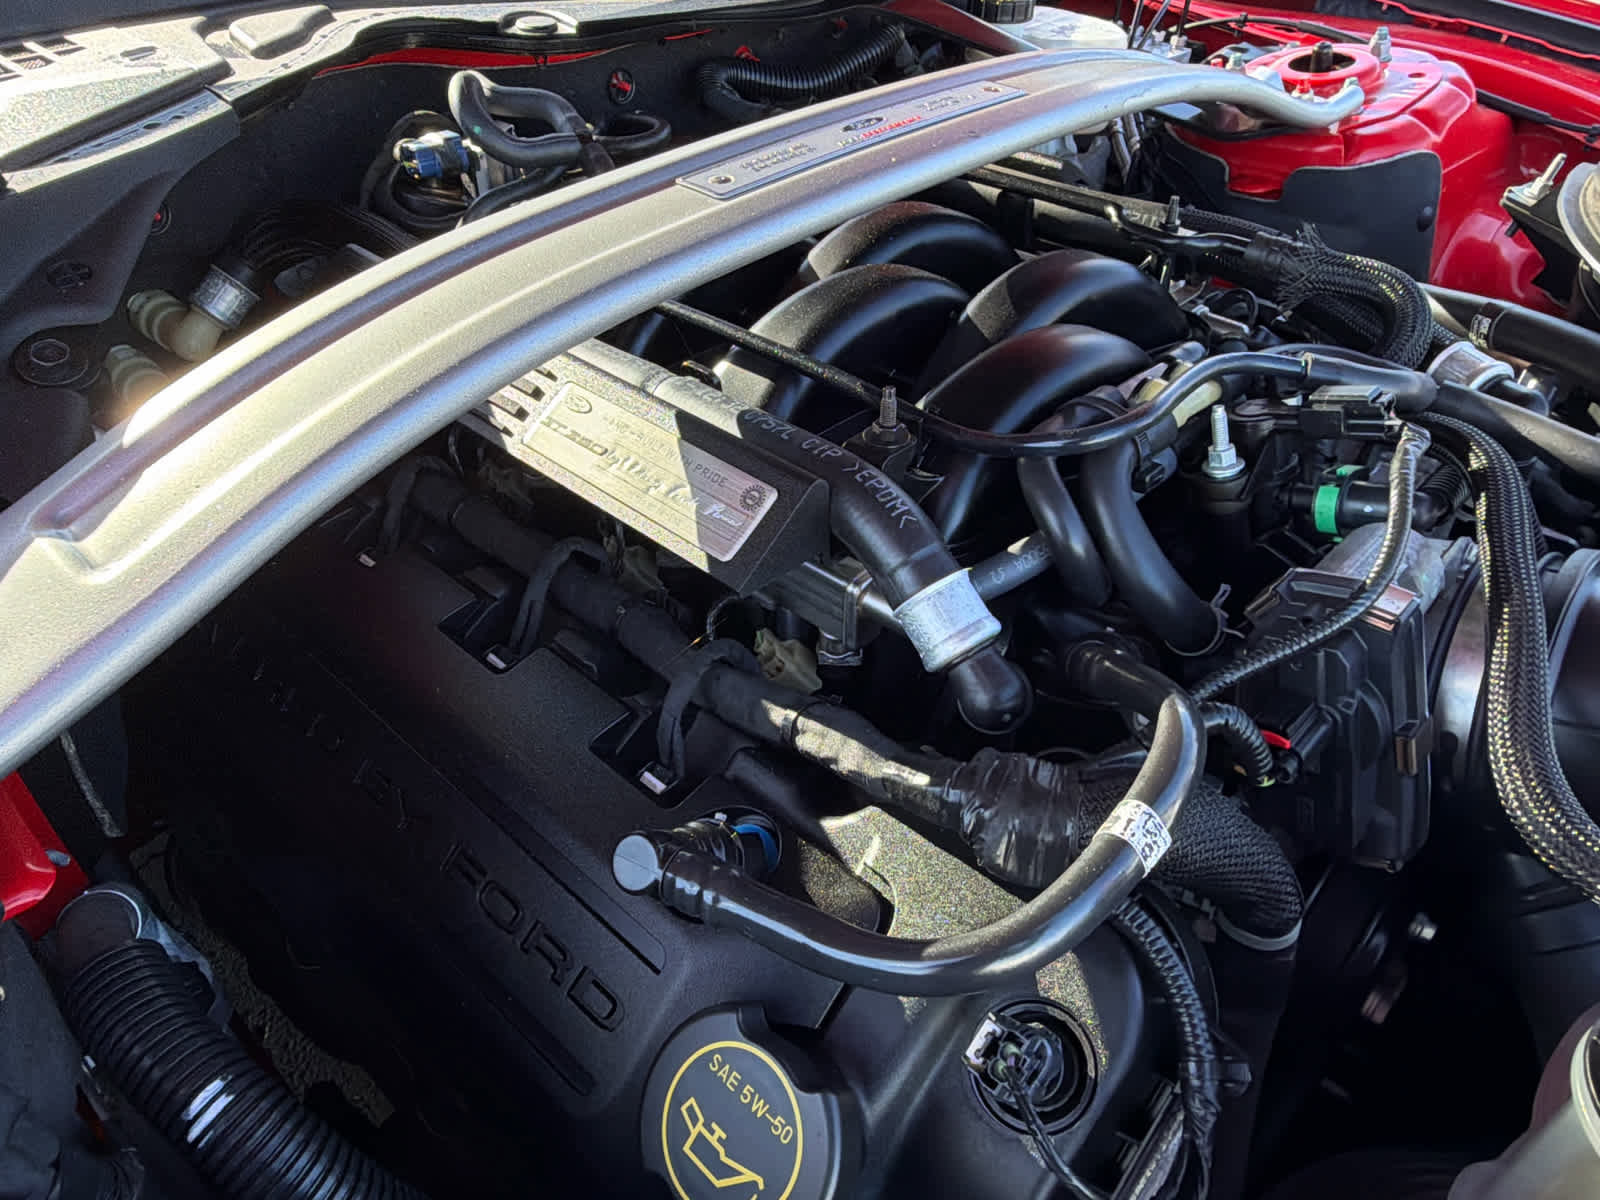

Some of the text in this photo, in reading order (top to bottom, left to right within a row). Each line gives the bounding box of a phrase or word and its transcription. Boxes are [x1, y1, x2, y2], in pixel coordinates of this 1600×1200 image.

[693, 463, 729, 489] PRIDE
[440, 840, 624, 1032] FORD
[708, 1053, 794, 1145] SAE 5W-50
